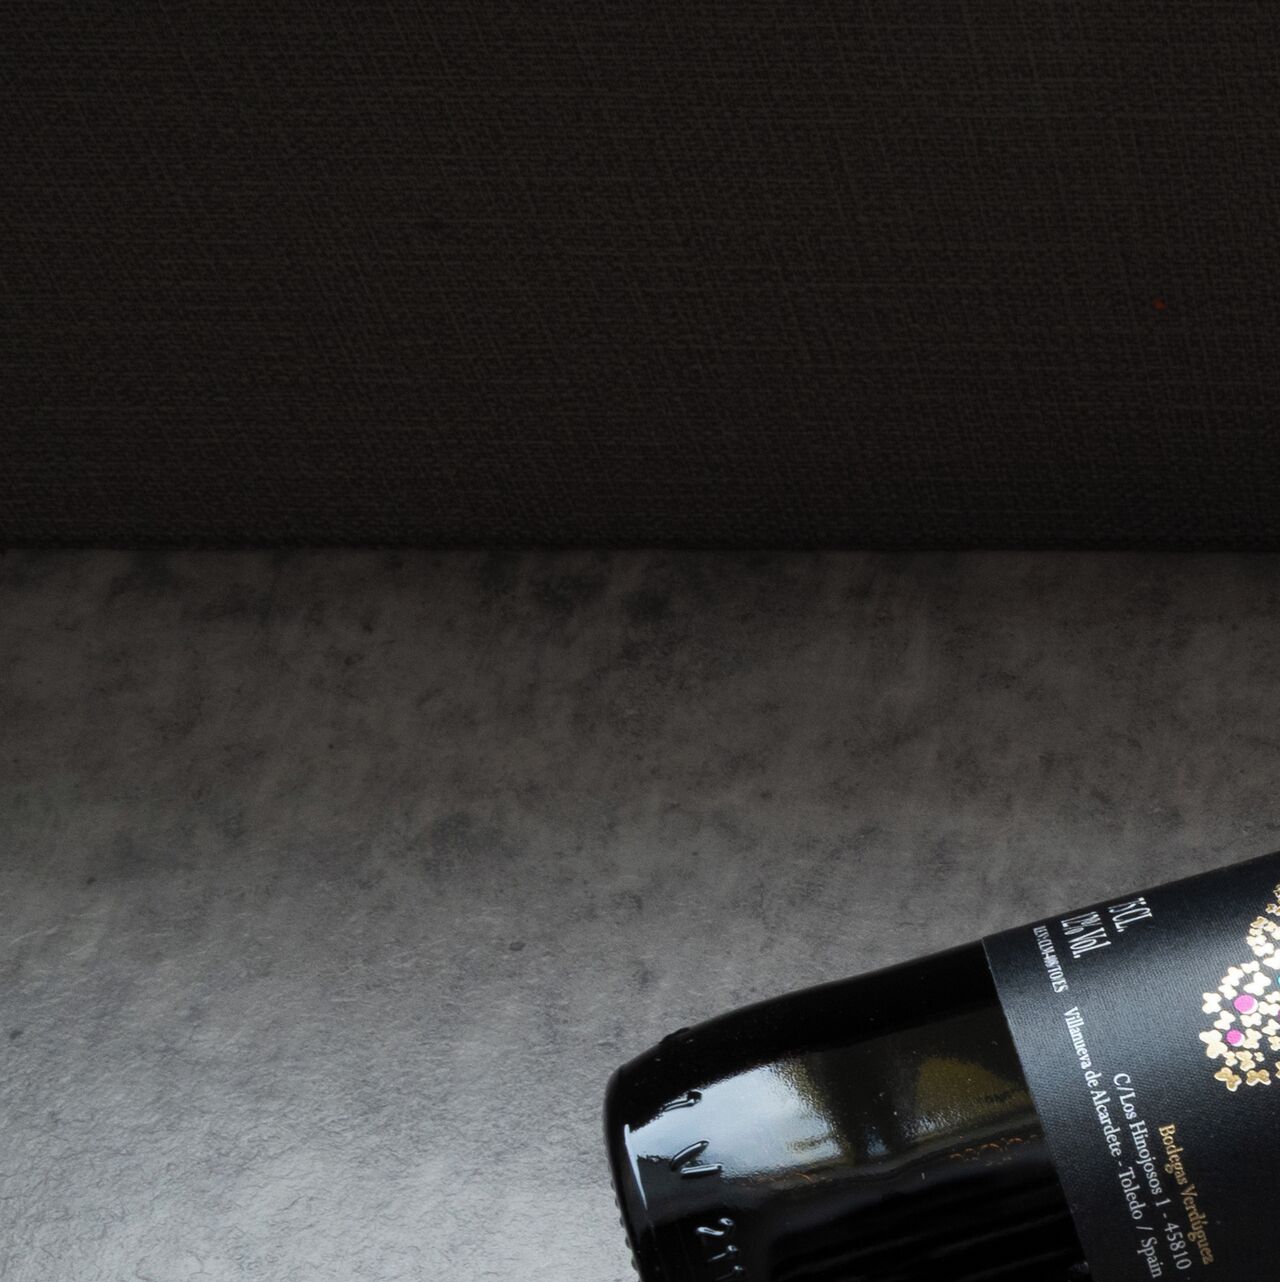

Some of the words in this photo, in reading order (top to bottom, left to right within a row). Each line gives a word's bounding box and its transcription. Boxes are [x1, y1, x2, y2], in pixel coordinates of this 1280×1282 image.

[1067, 927, 1112, 959] Vol.
[1064, 1006, 1092, 1070] Villanueva
[1084, 1072, 1102, 1088] de
[1090, 1090, 1122, 1157] Alcardete
[1118, 1166, 1147, 1221] Toledo
[1129, 1120, 1163, 1196] Hinojosos
[1155, 1197, 1172, 1208] 1
[1164, 1222, 1193, 1271] 45810
[1158, 1123, 1188, 1186] Bodegas
[1180, 1183, 1215, 1266] Verdúguez
[1137, 1236, 1164, 1279] Spain
